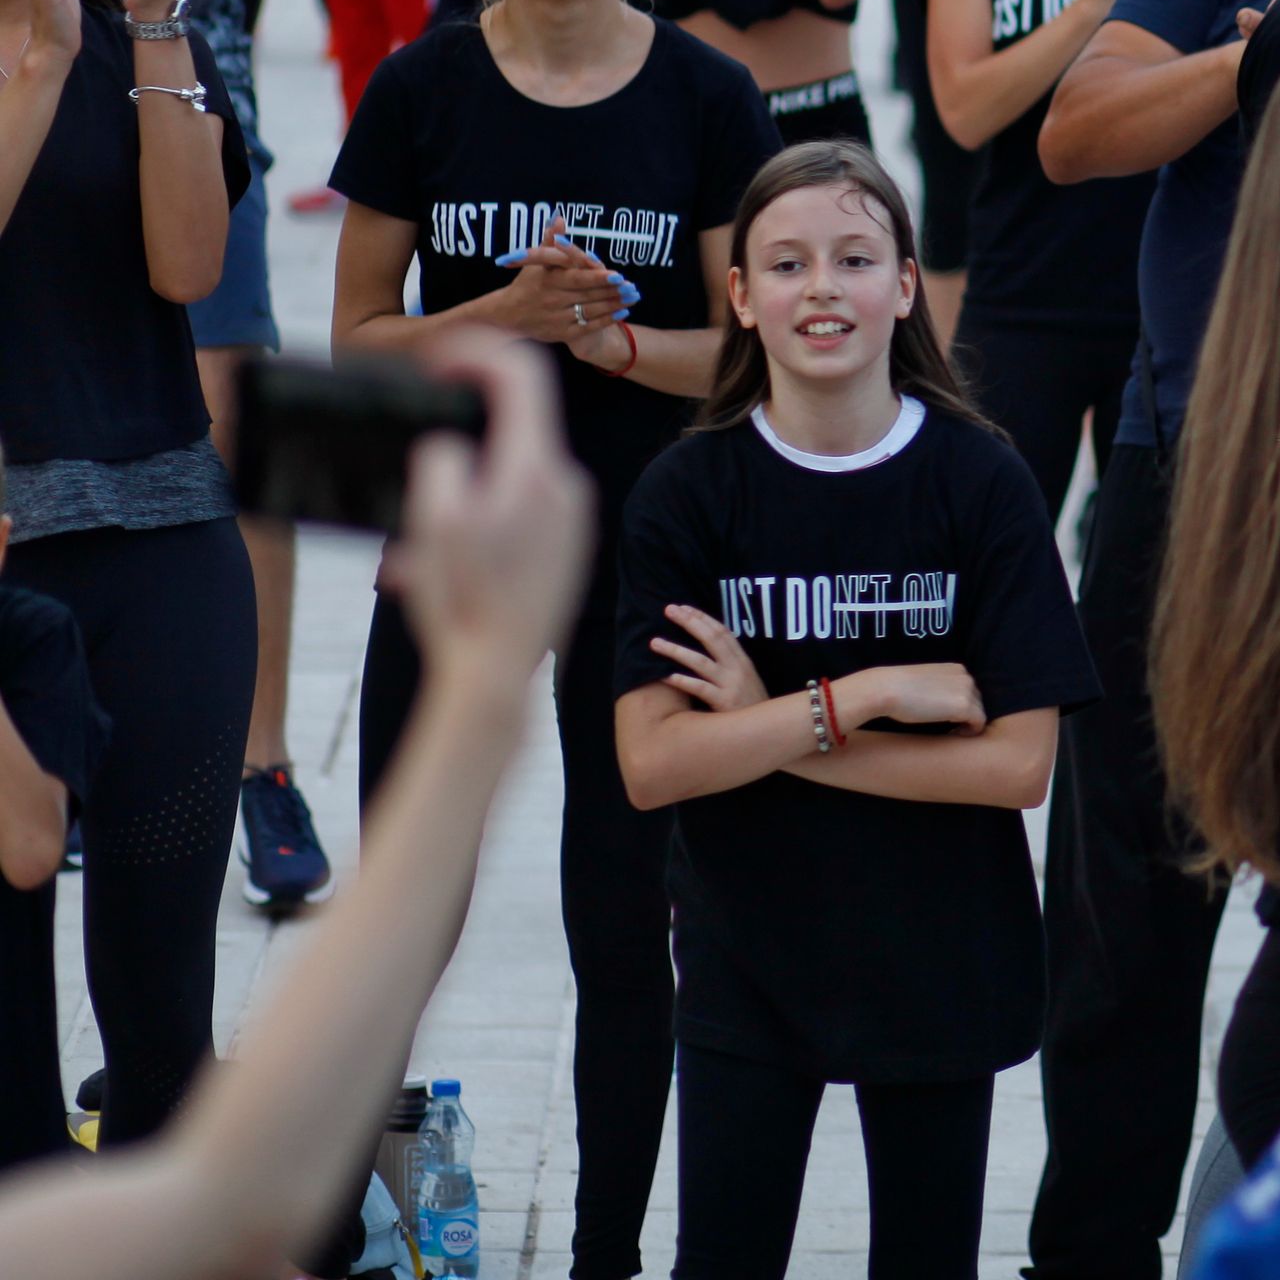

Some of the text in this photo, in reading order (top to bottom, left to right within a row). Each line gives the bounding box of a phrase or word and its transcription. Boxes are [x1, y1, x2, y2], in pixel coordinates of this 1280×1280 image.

[431, 202, 498, 257] JUST
[719, 576, 776, 639] UST
[786, 574, 892, 641] DON'T
[443, 1230, 473, 1243] ROSA
